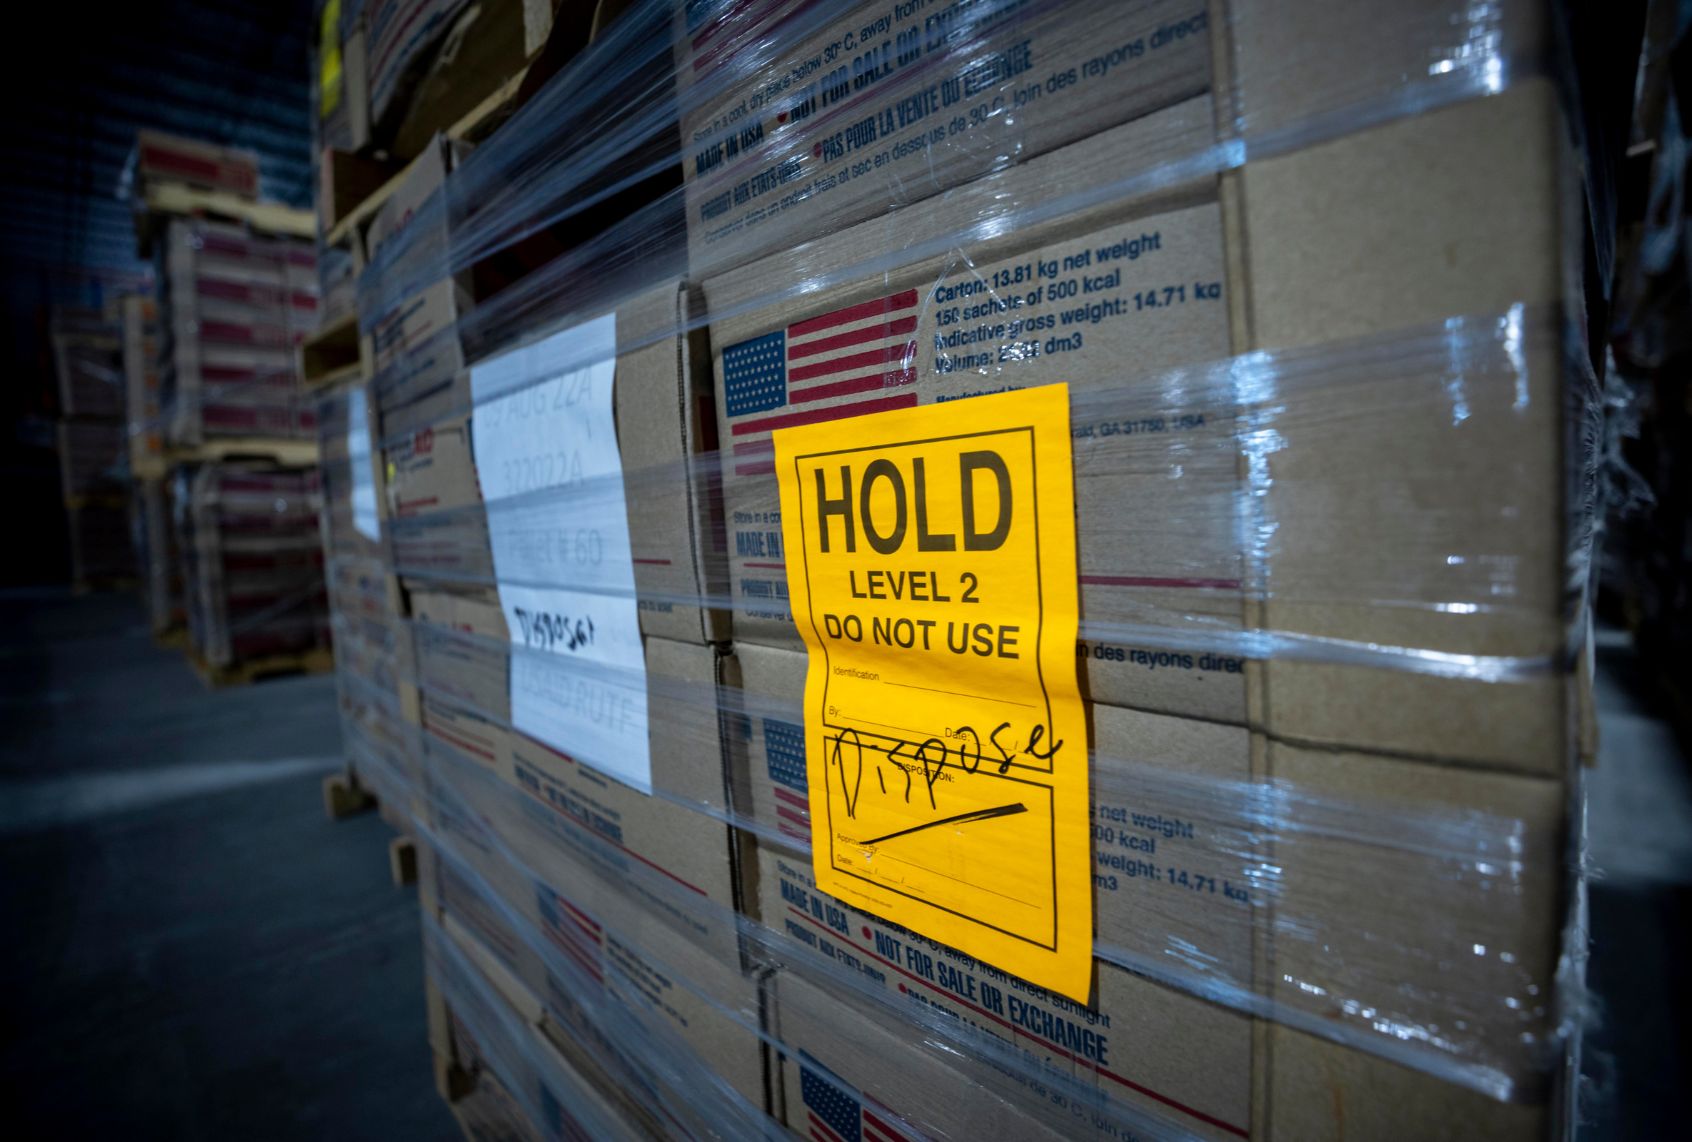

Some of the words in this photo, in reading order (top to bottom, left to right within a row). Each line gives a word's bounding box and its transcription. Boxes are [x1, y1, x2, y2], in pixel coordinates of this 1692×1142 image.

[860, 14, 893, 45] away
[895, 0, 926, 22] from
[695, 143, 725, 177] MADE
[726, 136, 738, 160] IN
[741, 121, 764, 150] USA
[821, 62, 850, 107] FOR
[852, 41, 895, 91] SALE
[822, 133, 845, 163] PAS
[846, 119, 877, 153] POUR
[879, 107, 896, 137] LA
[896, 84, 939, 128] VENTE
[941, 75, 961, 109] OU
[851, 160, 873, 178] sec
[873, 151, 891, 168] en
[948, 116, 967, 136] de
[1013, 83, 1042, 108] loin
[1046, 68, 1077, 94] des
[1082, 39, 1146, 79] rayons
[934, 278, 989, 305] Carton:
[992, 263, 1032, 289] 13.81
[1038, 258, 1059, 280] kg
[1063, 249, 1092, 273] net
[1096, 231, 1161, 262] weight
[935, 306, 960, 327] 150
[963, 298, 1023, 321] sachets
[1026, 285, 1044, 306] of
[1048, 279, 1078, 302] 500
[1082, 268, 1121, 294] kcal
[1008, 314, 1056, 340] gross
[1060, 299, 1128, 325] weight:
[1133, 284, 1186, 311] 14.71
[935, 350, 994, 374] Volume:
[1044, 331, 1083, 354] dm3
[814, 450, 1013, 555] HOLD
[736, 531, 766, 557] MADE
[850, 570, 951, 602] LEVEL
[959, 572, 979, 604] 2
[824, 614, 863, 643] DO
[872, 616, 936, 650] NOT
[947, 621, 1020, 660] USE
[1094, 643, 1125, 662] des
[1130, 649, 1194, 670] rayons
[833, 666, 880, 681] Identification
[829, 706, 842, 717] By:
[944, 727, 971, 742] Date:
[1101, 805, 1127, 824] net
[1131, 812, 1194, 839] weight
[1119, 830, 1156, 854] kcal
[1098, 851, 1161, 880] weight:
[1167, 868, 1216, 893] 14.71
[780, 878, 809, 913] MADE
[811, 895, 824, 922] IN
[825, 904, 849, 937] USA
[875, 929, 902, 964] NOT
[906, 945, 935, 981] FOR
[937, 961, 978, 1002] SALE
[980, 981, 1004, 1017] OR
[1007, 994, 1110, 1066] EXCHANGE
[978, 958, 1008, 984] from
[1010, 975, 1049, 1001] direct
[1051, 991, 1111, 1029] sunlight
